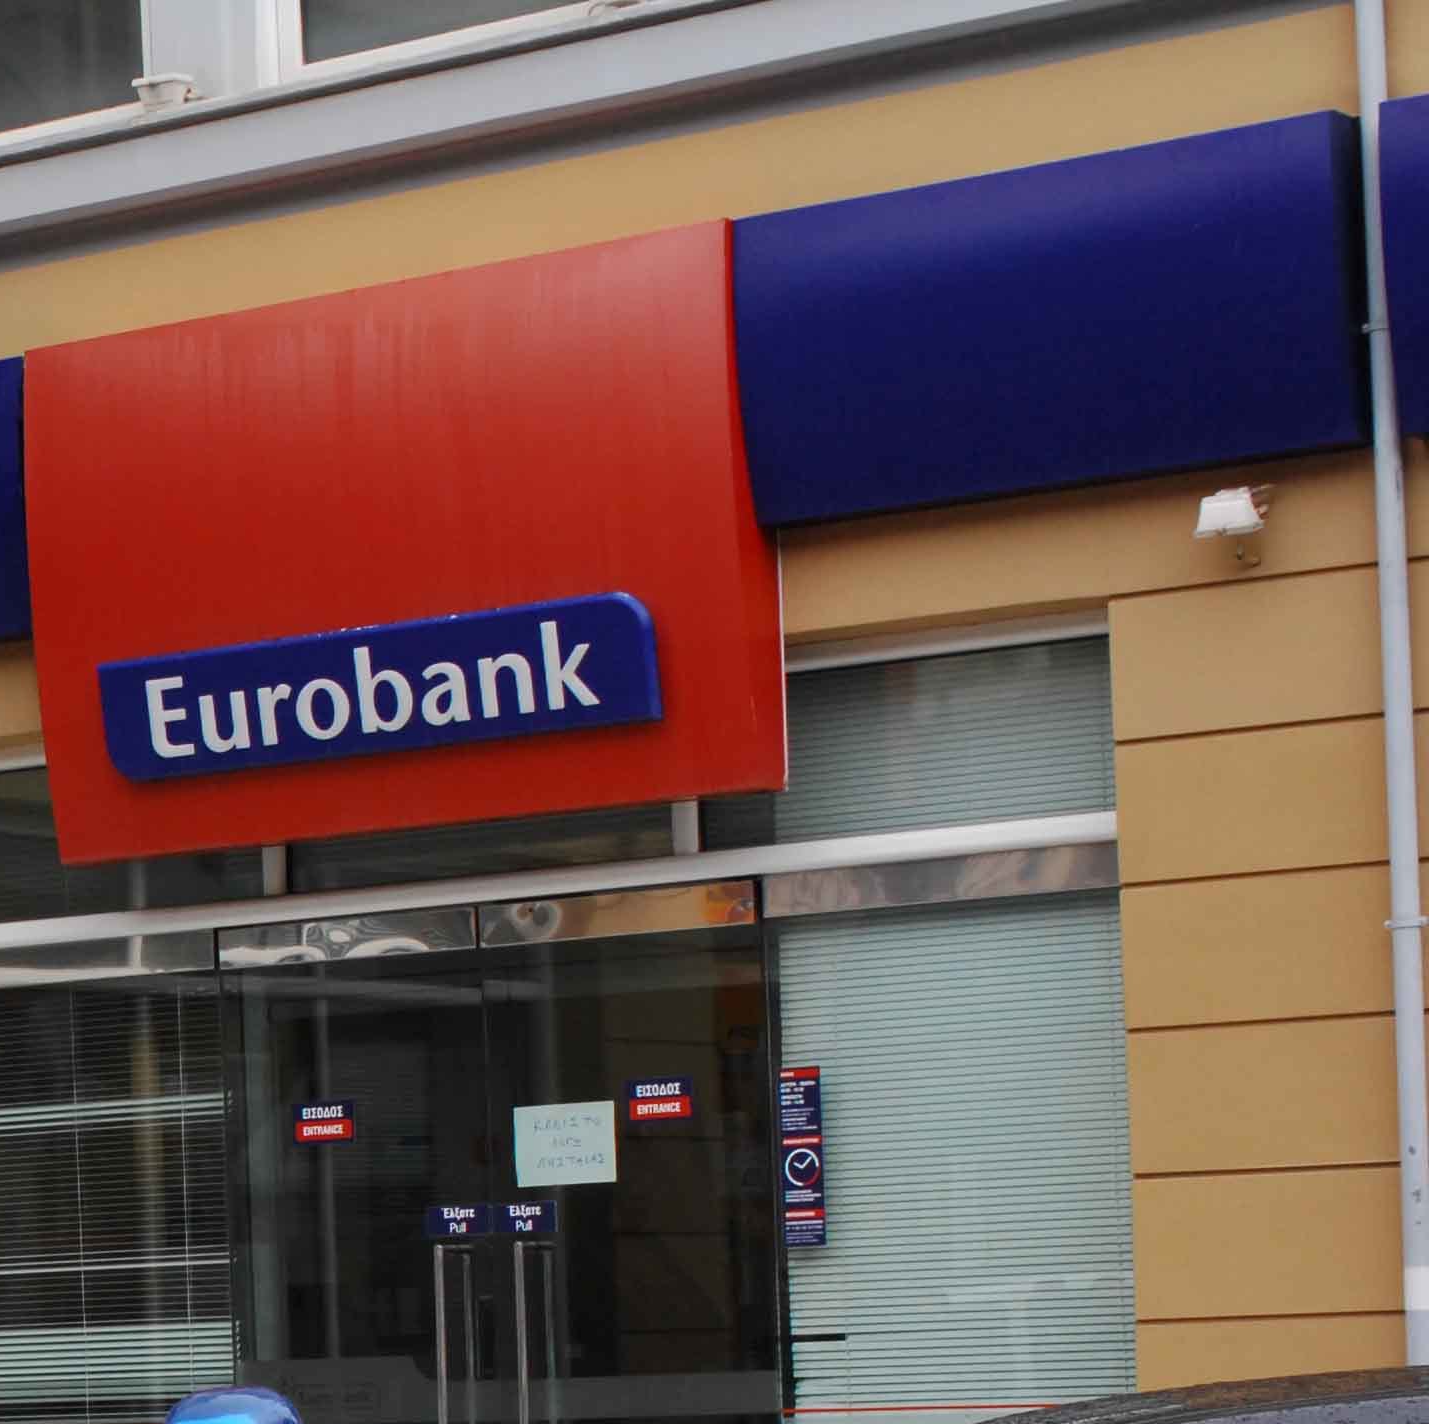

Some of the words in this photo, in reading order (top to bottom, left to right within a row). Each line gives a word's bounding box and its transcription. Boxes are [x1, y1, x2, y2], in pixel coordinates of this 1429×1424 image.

[145, 621, 600, 758] Eurobank
[636, 1082, 682, 1098] ΕΙΣΟΔΟΣ
[302, 1105, 344, 1119] ΕΙΣΟΔΟΣ
[637, 1102, 682, 1115] ENTRANCE
[303, 1123, 344, 1137] ENTRANCE
[449, 1222, 467, 1233] Pull
[515, 1219, 533, 1232] Pull
